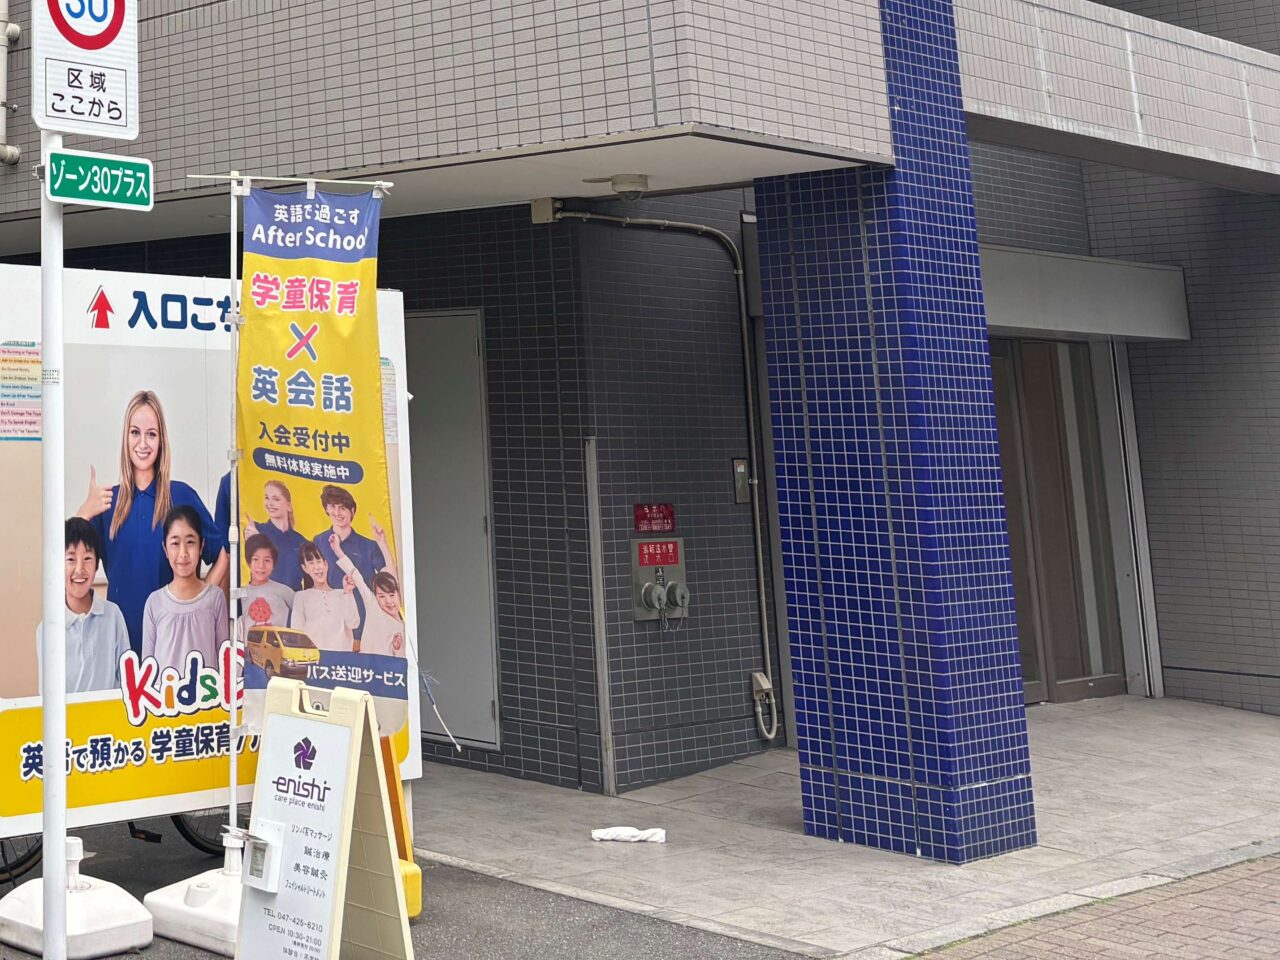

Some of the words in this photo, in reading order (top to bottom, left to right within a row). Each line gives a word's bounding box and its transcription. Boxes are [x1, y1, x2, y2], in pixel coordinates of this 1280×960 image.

[67, 67, 106, 92] 区域
[51, 92, 123, 121] ここから
[51, 159, 148, 199] ゾーン30プラス
[273, 204, 360, 226] 英語で過ごす
[251, 273, 360, 316] 学童保育
[251, 366, 353, 413] 英会話
[258, 421, 351, 454] 入会受付中
[264, 452, 350, 480] 無料体験実施中
[306, 663, 406, 687] バス送迎サービス
[22, 736, 144, 777] 英で預かる
[271, 774, 332, 803] enishi
[274, 794, 288, 805] care
[288, 796, 306, 809] place
[307, 801, 326, 812] enishi
[268, 923, 286, 935] OPEN
